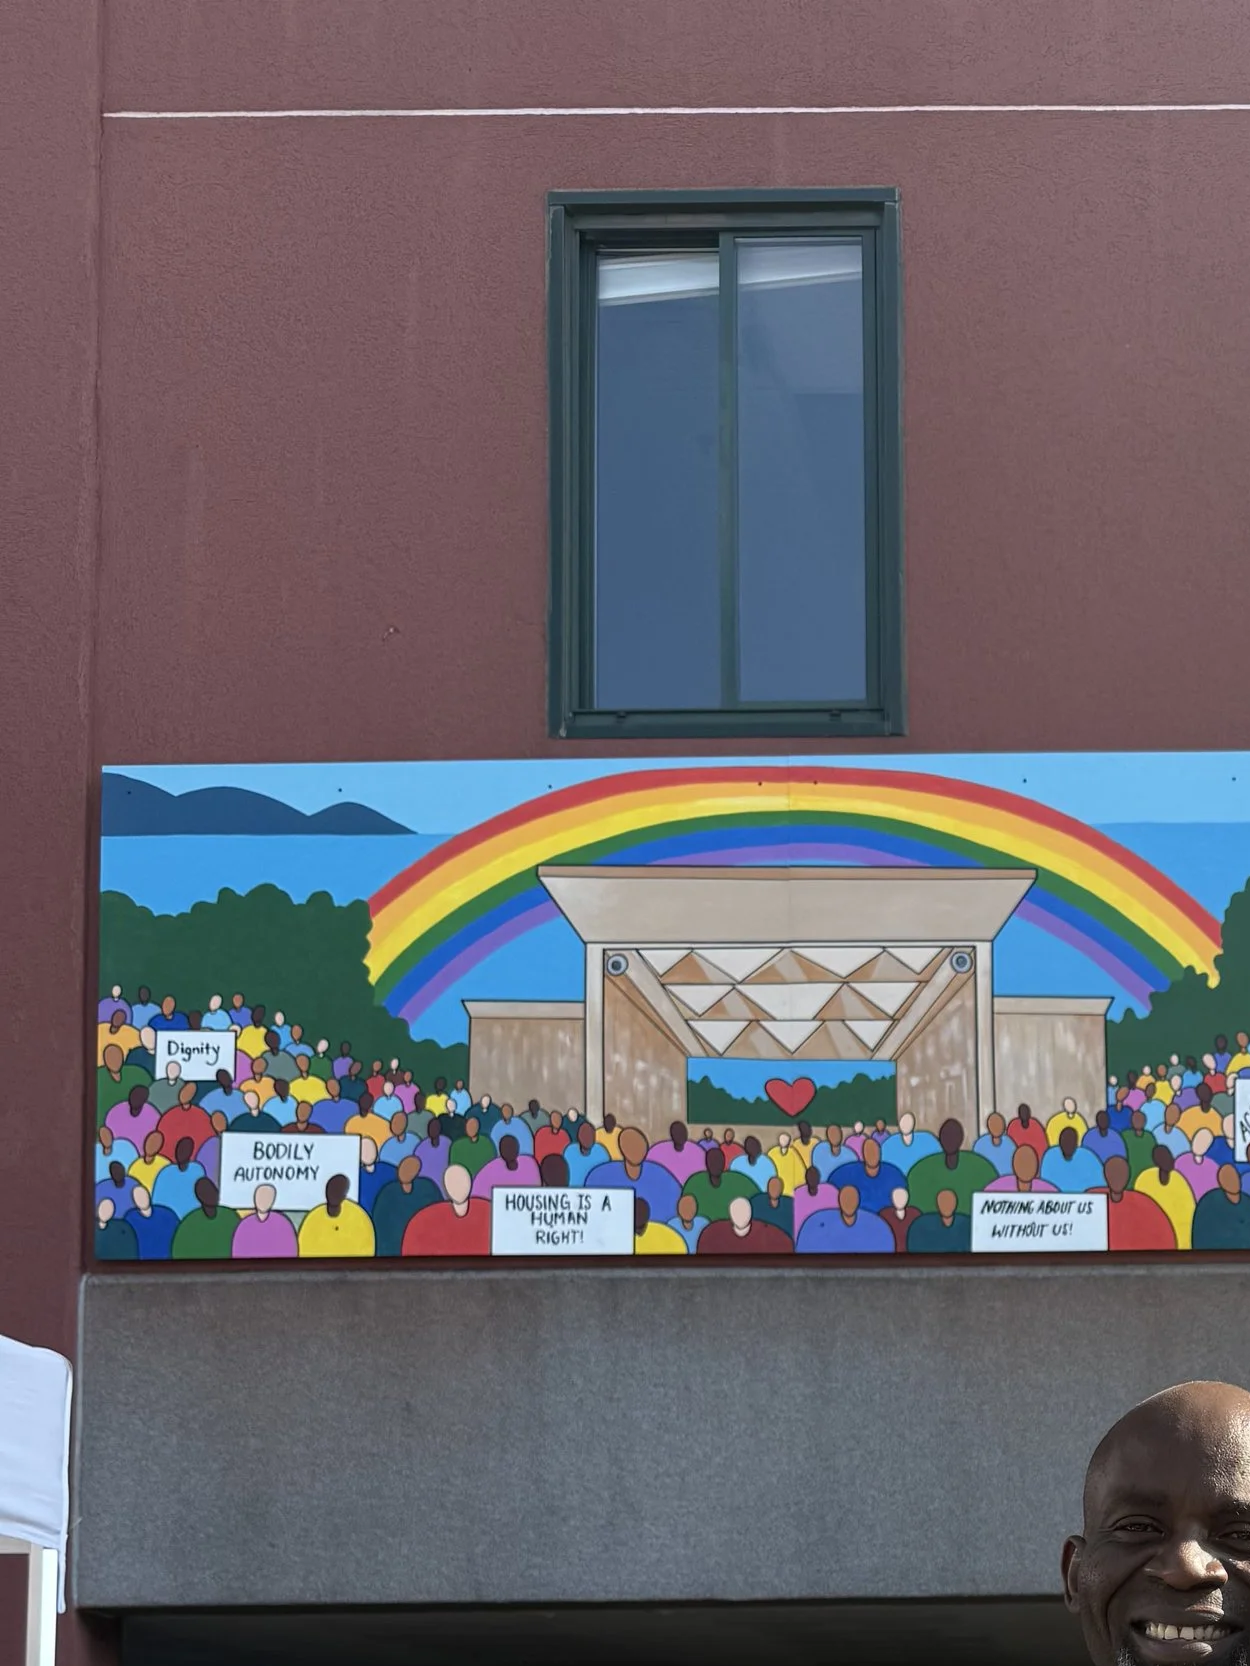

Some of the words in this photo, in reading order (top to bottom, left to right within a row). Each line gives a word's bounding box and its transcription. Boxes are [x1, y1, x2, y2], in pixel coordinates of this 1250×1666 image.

[167, 1040, 220, 1066] Dignity
[253, 1142, 314, 1160] BODILY
[234, 1166, 319, 1182] AUTONOMY
[505, 1194, 571, 1212] HOUSING
[578, 1194, 592, 1211] IS
[601, 1195, 612, 1212] A
[981, 1200, 1035, 1215] NOTHING
[1036, 1200, 1075, 1215] ABOUT
[1077, 1201, 1094, 1215] US
[530, 1211, 588, 1227] HUMAN
[535, 1229, 584, 1245] RIGHT!
[991, 1221, 1048, 1238] WITHOUT
[1052, 1223, 1074, 1236] US!
